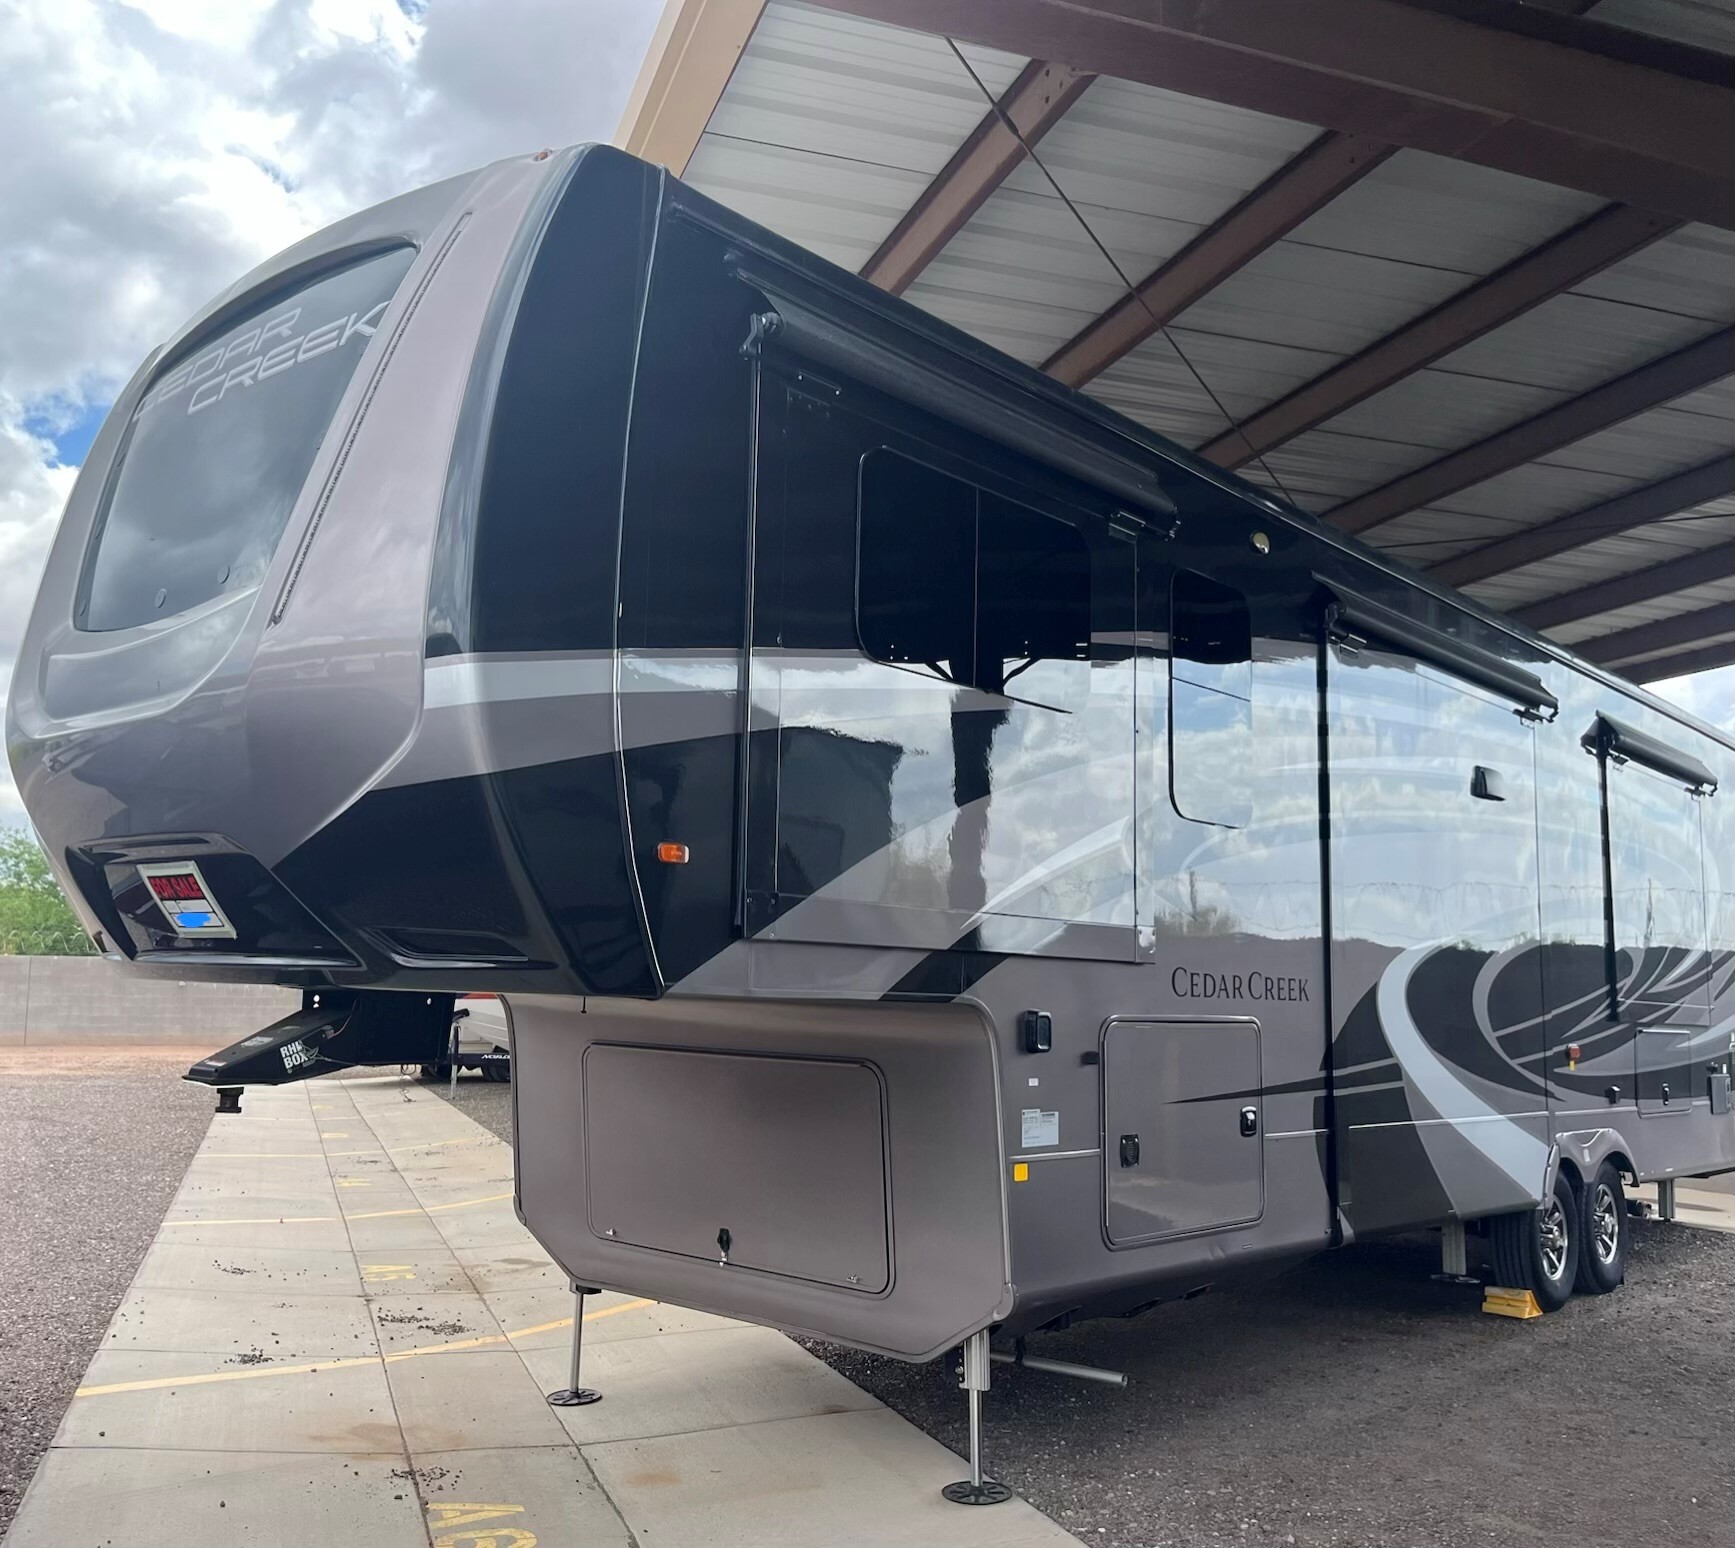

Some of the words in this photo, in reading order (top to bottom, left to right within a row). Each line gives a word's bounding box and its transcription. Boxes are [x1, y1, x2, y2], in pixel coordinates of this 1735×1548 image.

[132, 307, 302, 422] CEDAR
[187, 299, 392, 416] CREEK
[147, 877, 177, 899] FOR
[169, 875, 205, 898] SALE
[283, 1051, 309, 1069] BOX
